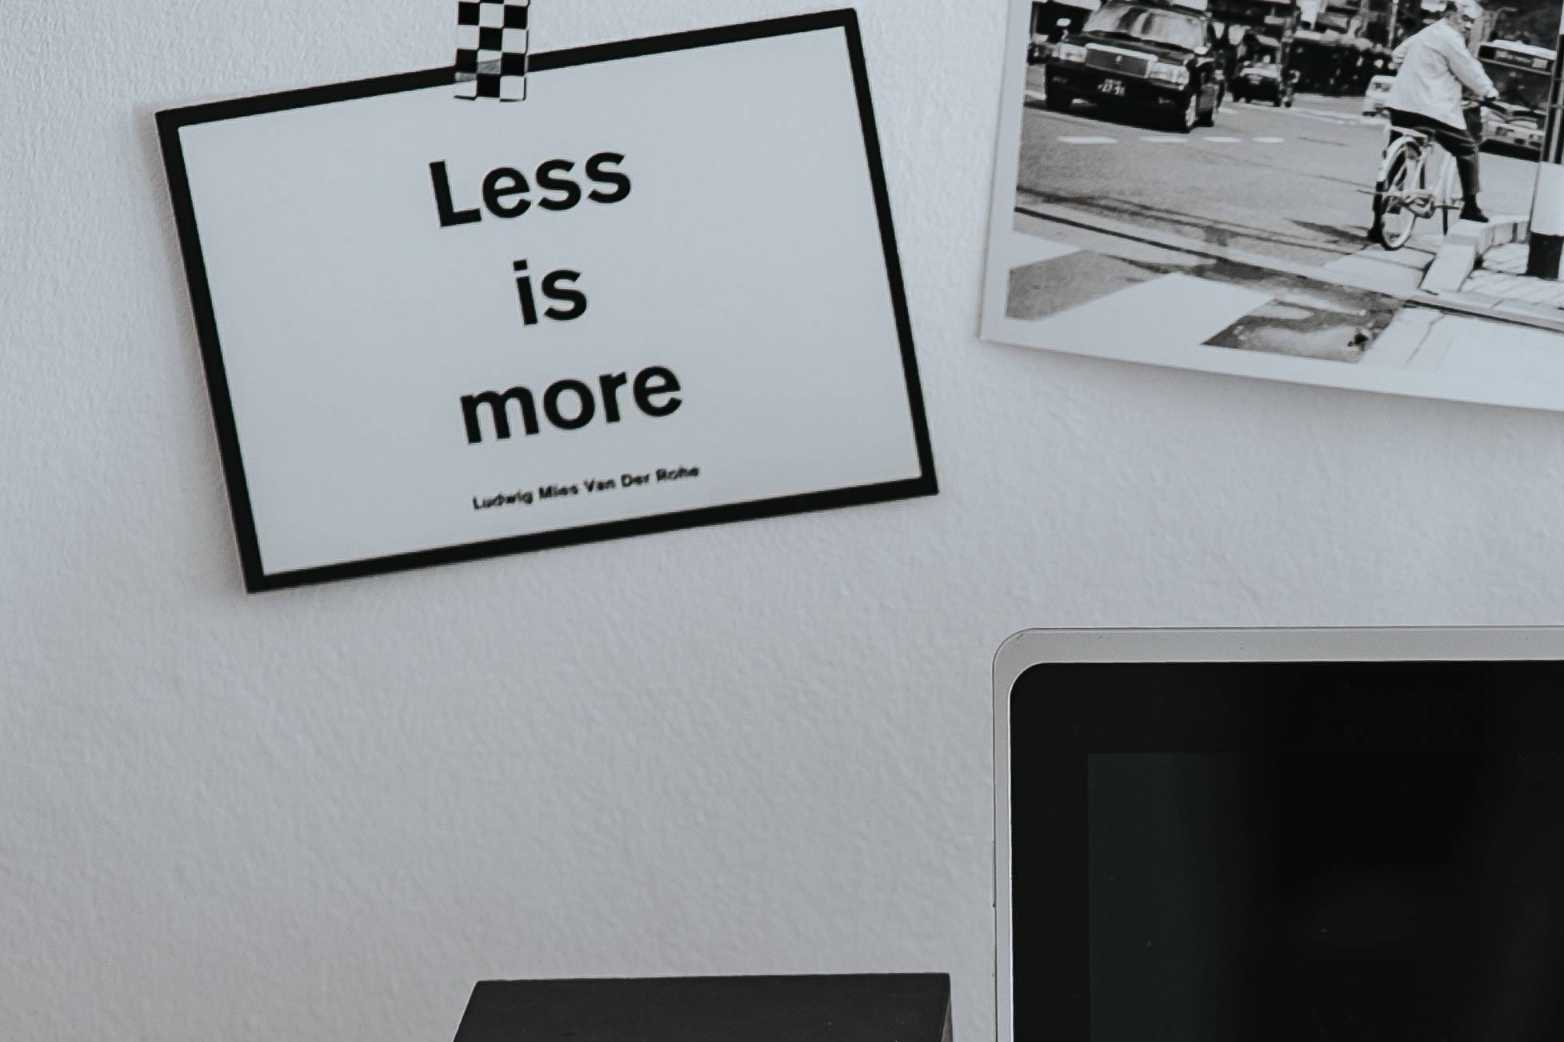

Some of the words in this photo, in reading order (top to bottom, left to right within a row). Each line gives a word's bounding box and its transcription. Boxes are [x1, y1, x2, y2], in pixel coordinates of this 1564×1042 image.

[429, 149, 632, 227] Less
[512, 259, 587, 326] is
[459, 363, 682, 445] more
[472, 491, 533, 510] Ludwig
[538, 485, 579, 499] Mies
[584, 478, 616, 493] Van
[621, 473, 650, 488] Der
[656, 466, 699, 482] Rohe
